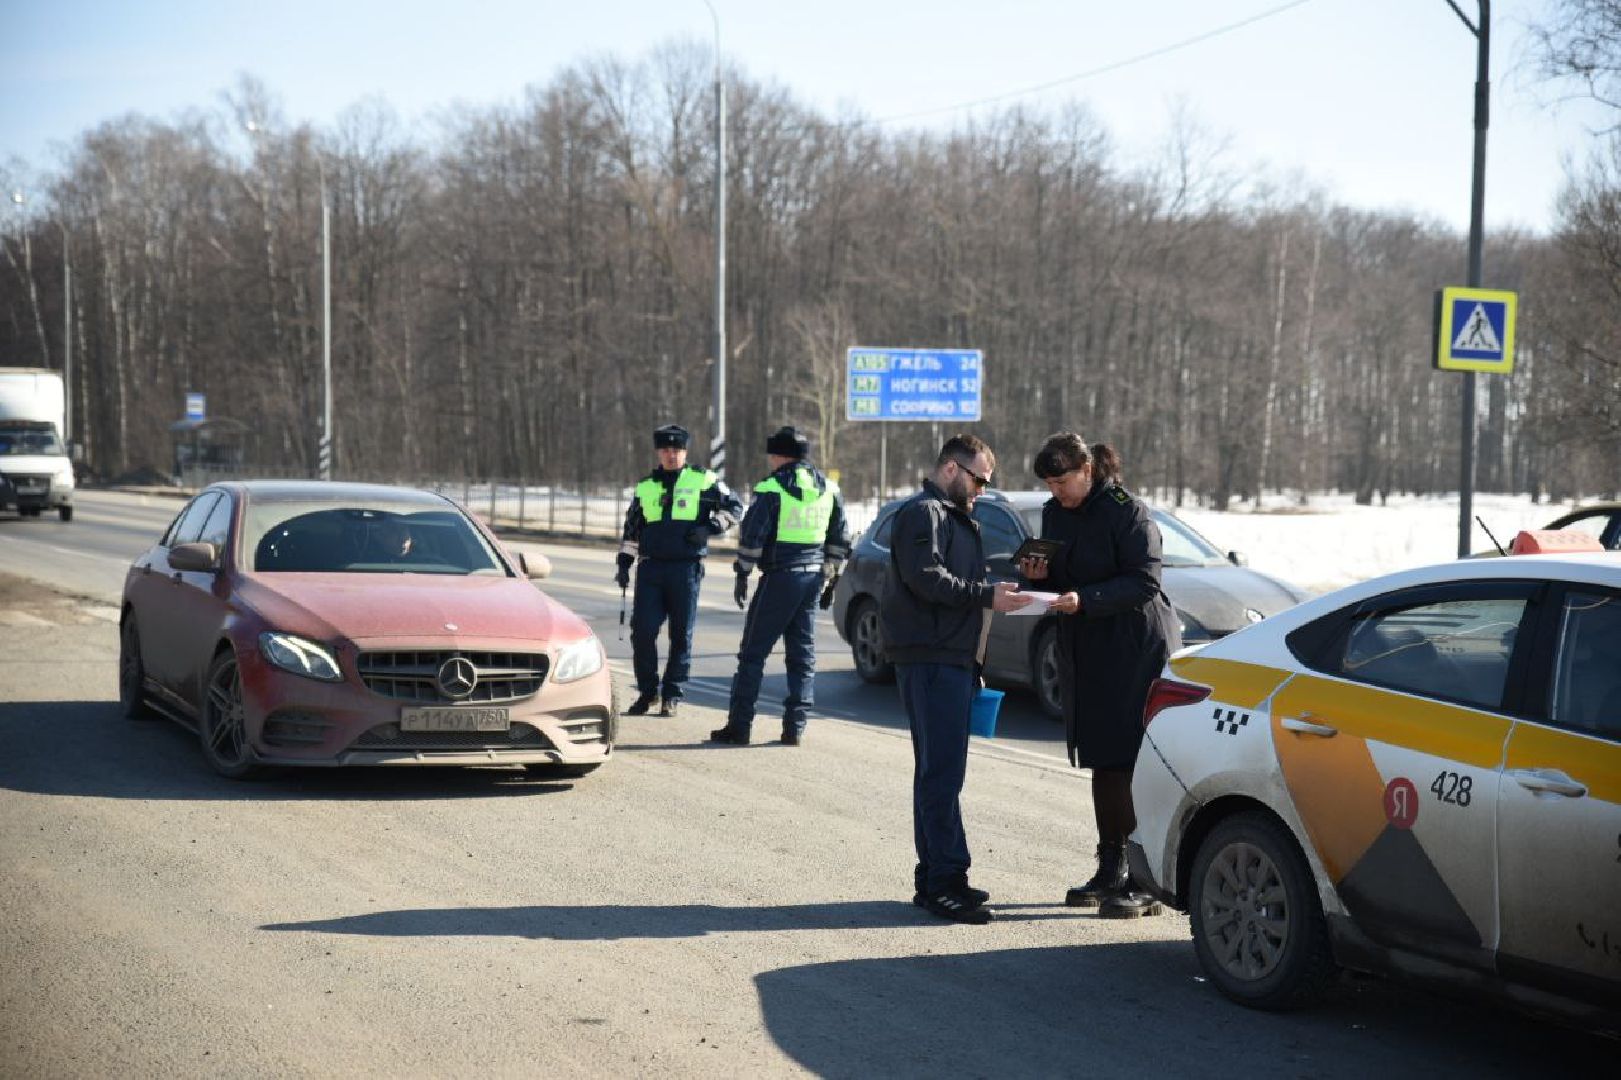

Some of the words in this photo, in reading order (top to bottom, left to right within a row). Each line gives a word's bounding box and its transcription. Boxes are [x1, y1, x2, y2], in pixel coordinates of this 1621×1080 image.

[890, 356, 943, 370] ГЖЕЛЬ
[890, 378, 957, 393] НОГИНСК
[1431, 771, 1473, 807] 428
[1393, 786, 1408, 819] Я
